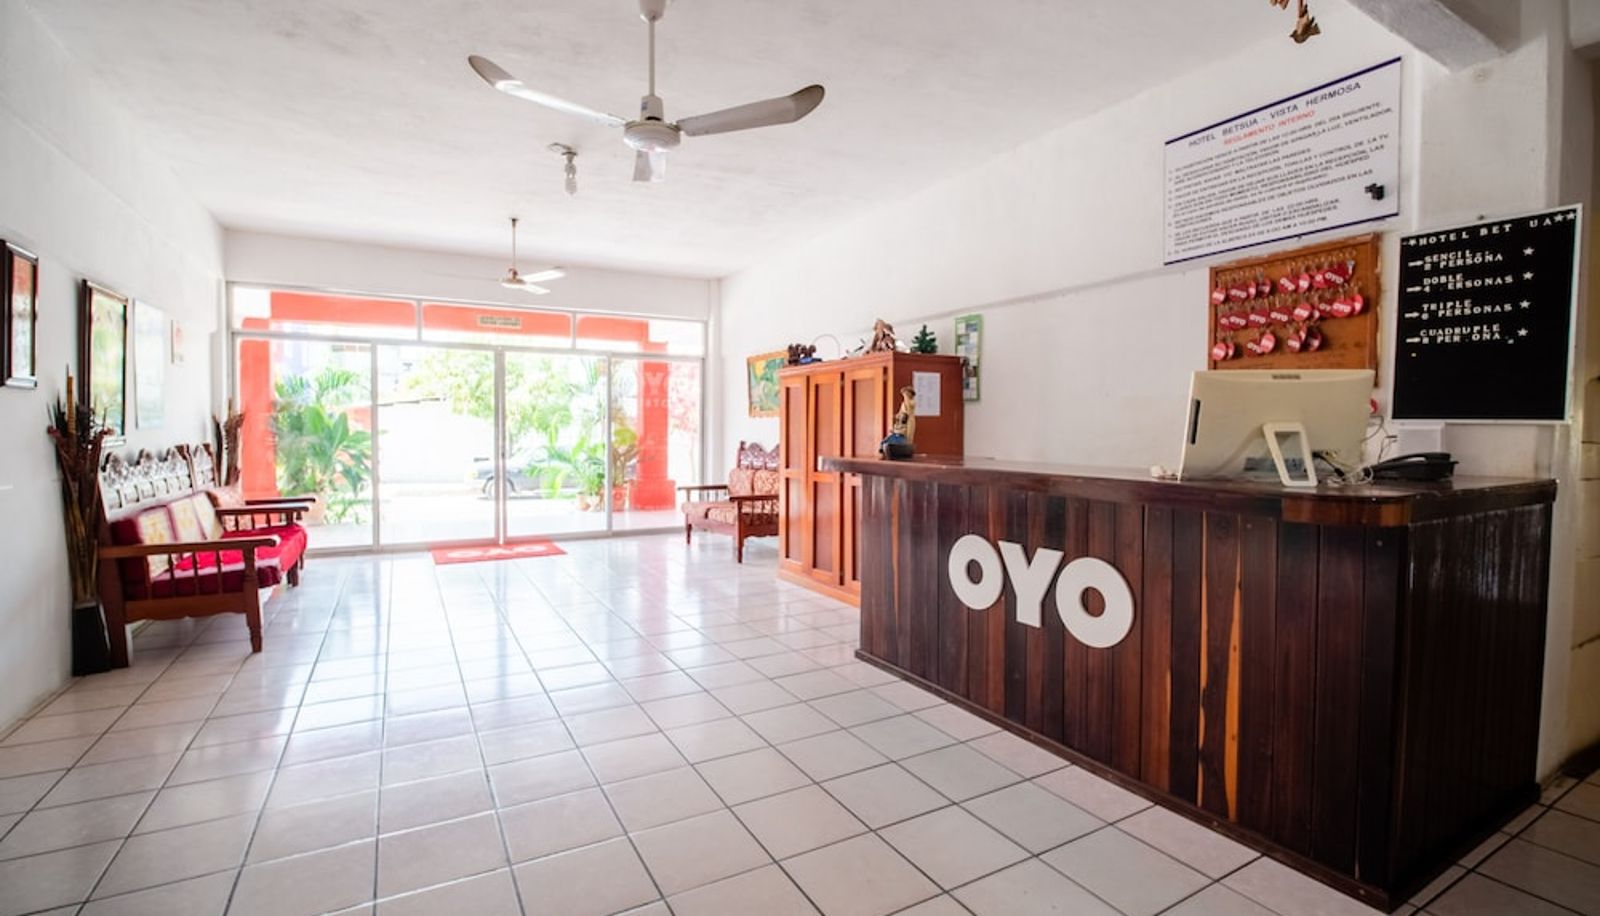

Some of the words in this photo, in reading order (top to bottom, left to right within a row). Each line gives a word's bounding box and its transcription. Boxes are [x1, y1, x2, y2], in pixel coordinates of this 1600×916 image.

[1189, 133, 1216, 148] HOTEL
[1222, 117, 1258, 136] BETSUA
[1269, 102, 1298, 120] VISTA
[1305, 82, 1361, 108] HERMOSA
[1278, 109, 1314, 127] INTERNO
[1419, 232, 1469, 247] HOTEL
[1424, 250, 1491, 264] SENCIL
[1440, 255, 1503, 269] PERSONA
[1424, 274, 1464, 286] DOBLE
[1440, 275, 1513, 291] ERSONAS
[1422, 300, 1472, 312] TRIPLE
[1438, 304, 1513, 318] PERSONAS
[1420, 324, 1501, 337] CUADRUPLE
[948, 535, 1135, 649] OYO
